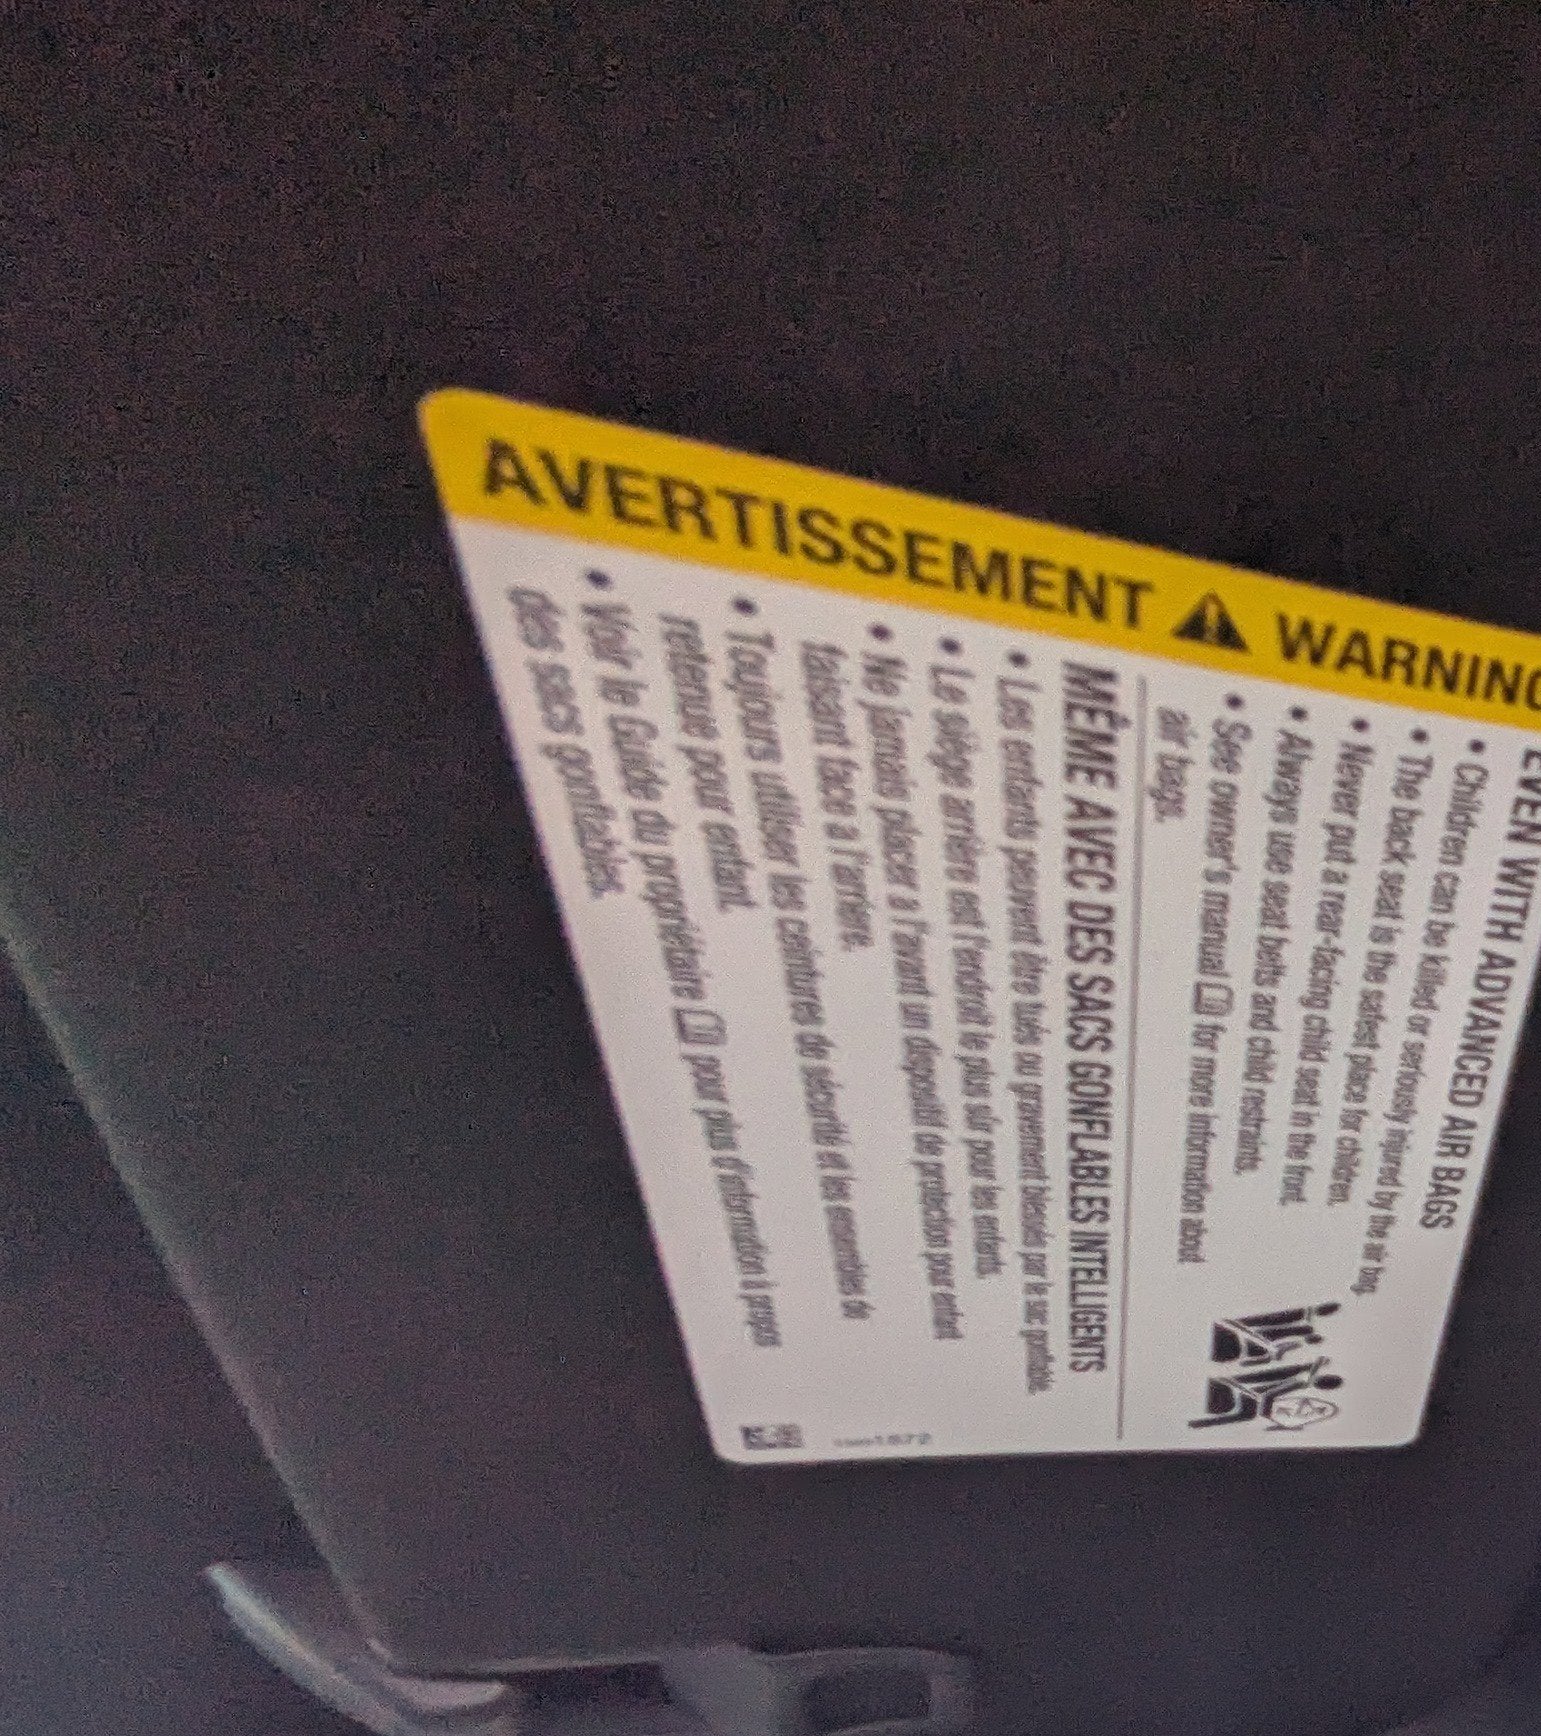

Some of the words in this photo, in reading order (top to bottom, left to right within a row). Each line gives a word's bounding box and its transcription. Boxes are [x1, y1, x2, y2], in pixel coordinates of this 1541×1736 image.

[484, 442, 1147, 625] AVERTISSEMENT
[505, 585, 564, 652] des
[579, 601, 635, 670] Voir
[527, 660, 583, 735] sacs
[597, 674, 647, 708] le
[659, 613, 718, 740] retenue
[723, 630, 782, 763] Toujours
[799, 640, 852, 749] faisant
[861, 651, 906, 697] Ne
[928, 662, 975, 705] Le
[996, 675, 1040, 732] Les
[1063, 662, 1129, 787] MÊME
[1156, 706, 1196, 749] air
[606, 713, 666, 802] Guide
[856, 699, 915, 801] jamais
[926, 709, 975, 789] siège
[1209, 717, 1252, 775] See
[676, 744, 733, 815] pour
[814, 754, 859, 817] face
[999, 737, 1043, 841] enfants
[1146, 751, 1193, 823] bags.
[1263, 728, 1313, 825] Always
[1331, 741, 1374, 819] Never
[1390, 754, 1434, 801] The
[539, 742, 625, 898] gonflables.
[628, 806, 676, 846] du
[748, 769, 800, 867] utiliser
[1202, 779, 1239, 884] owner's
[1382, 805, 1422, 866] back
[1438, 761, 1489, 866] Children
[700, 820, 757, 912] enfant.
[870, 804, 920, 891] placer
[1064, 795, 1116, 892] AVEC
[1264, 829, 1294, 875] use
[1321, 821, 1357, 866] put
[766, 871, 807, 912] les
[946, 887, 986, 930] est
[999, 844, 1043, 946] peuvent
[1258, 878, 1291, 931] seat
[1372, 869, 1406, 921] seat
[1429, 870, 1460, 915] can
[1484, 856, 1540, 943] WITH
[632, 851, 706, 1001] propriétaire
[1065, 899, 1115, 965] DES
[1196, 889, 1230, 979] manual
[1298, 889, 1346, 1011] rear-facing
[1367, 923, 1402, 946] is
[1421, 918, 1456, 949] be
[775, 916, 824, 1027] ceintures
[890, 917, 933, 998] l'avant
[951, 932, 993, 1027] l'endroit
[1008, 949, 1049, 997] être
[1252, 933, 1289, 988] belts
[1361, 949, 1397, 985] the
[1409, 952, 1450, 1011] killed
[898, 1001, 931, 1031] un
[1010, 1000, 1051, 1046] tués
[1065, 972, 1114, 1052] SACS
[1190, 1021, 1227, 1052] for
[1247, 991, 1280, 1033] and
[1297, 1012, 1332, 1064] child
[1351, 987, 1387, 1050] safest
[1405, 1013, 1432, 1037] or
[1448, 949, 1516, 1108] ADVANCED
[793, 1030, 835, 1061] de
[957, 1029, 995, 1052] le
[1013, 1050, 1042, 1077] ou
[1242, 1034, 1276, 1084] child
[680, 1052, 729, 1104] pour
[900, 1034, 947, 1129] dispositif
[953, 1053, 995, 1099] plus
[1187, 1055, 1217, 1108] more
[1291, 1065, 1321, 1108] seat
[1342, 1051, 1377, 1104] place
[1382, 1040, 1426, 1125] seriously
[692, 1107, 741, 1152] plus
[799, 1064, 849, 1147] sécurité
[962, 1101, 1001, 1135] sûr
[1008, 1081, 1049, 1182] gravement
[1234, 1086, 1267, 1175] restraints.
[1289, 1109, 1321, 1129] in
[1338, 1107, 1370, 1133] for
[814, 1149, 851, 1171] et
[912, 1130, 947, 1157] de
[960, 1136, 997, 1181] pour
[1066, 1060, 1112, 1224] GONFLABLES
[1180, 1111, 1217, 1214] information
[1285, 1131, 1317, 1161] the
[1375, 1127, 1412, 1188] injured
[1435, 1113, 1478, 1159] AIR
[818, 1173, 855, 1203] les
[968, 1183, 1003, 1211] les
[1279, 1163, 1313, 1207] front.
[1326, 1135, 1362, 1206] children.
[1419, 1165, 1466, 1230] BAGS
[911, 1159, 954, 1249] protection
[1019, 1183, 1052, 1249] blessés
[1365, 1189, 1401, 1212] by
[1366, 1213, 1396, 1240] the
[824, 1204, 867, 1297] ensembles
[1016, 1250, 1048, 1279] par
[1177, 1216, 1208, 1264] about
[1362, 1241, 1389, 1264] air
[920, 1250, 955, 1289] pour
[1022, 1280, 1053, 1297] le
[839, 1298, 875, 1320] de
[929, 1290, 964, 1341] enfant
[1023, 1298, 1049, 1325] sac
[1068, 1229, 1109, 1372] INTELLIGENTS
